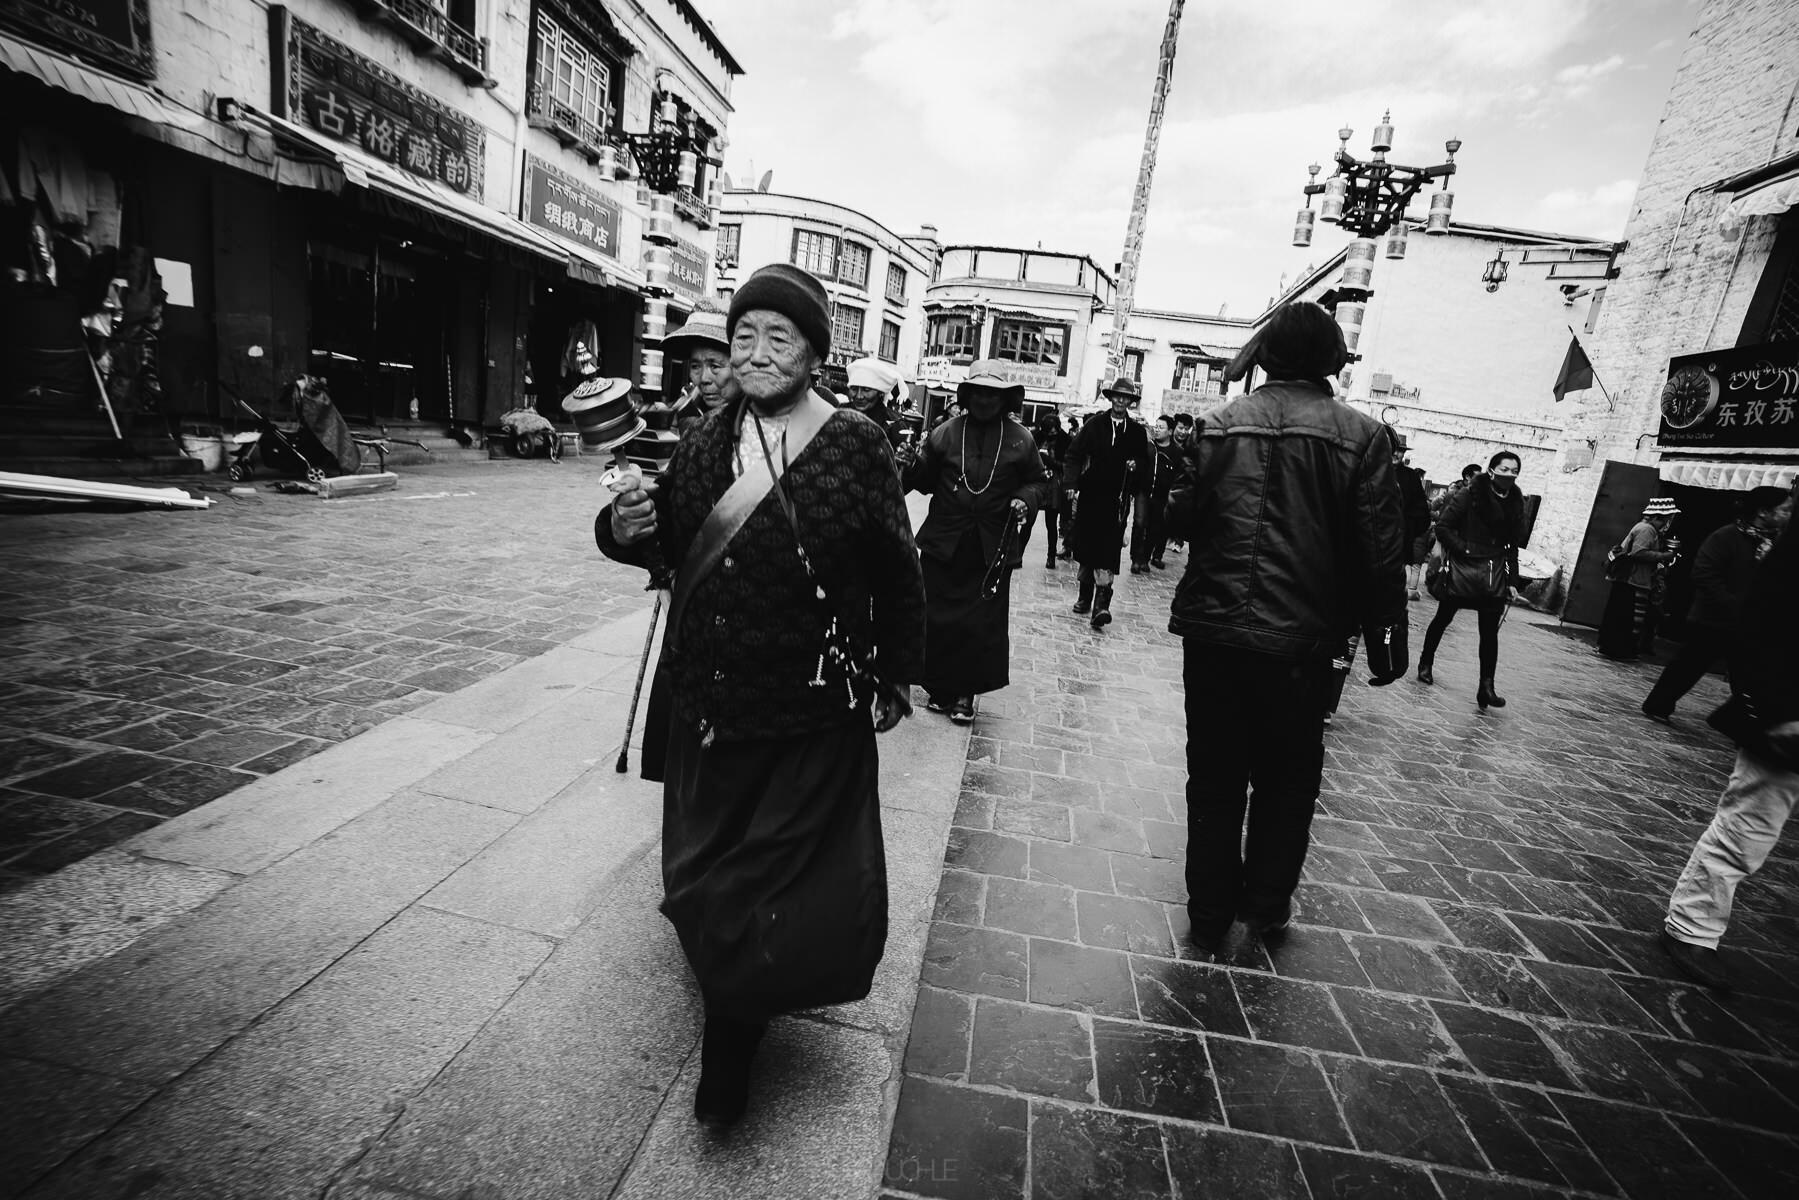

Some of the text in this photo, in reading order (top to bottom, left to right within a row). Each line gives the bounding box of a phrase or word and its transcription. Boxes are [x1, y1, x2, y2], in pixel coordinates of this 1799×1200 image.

[314, 90, 470, 189] 古格藏韵
[1716, 397, 1798, 428] 东孜苏
